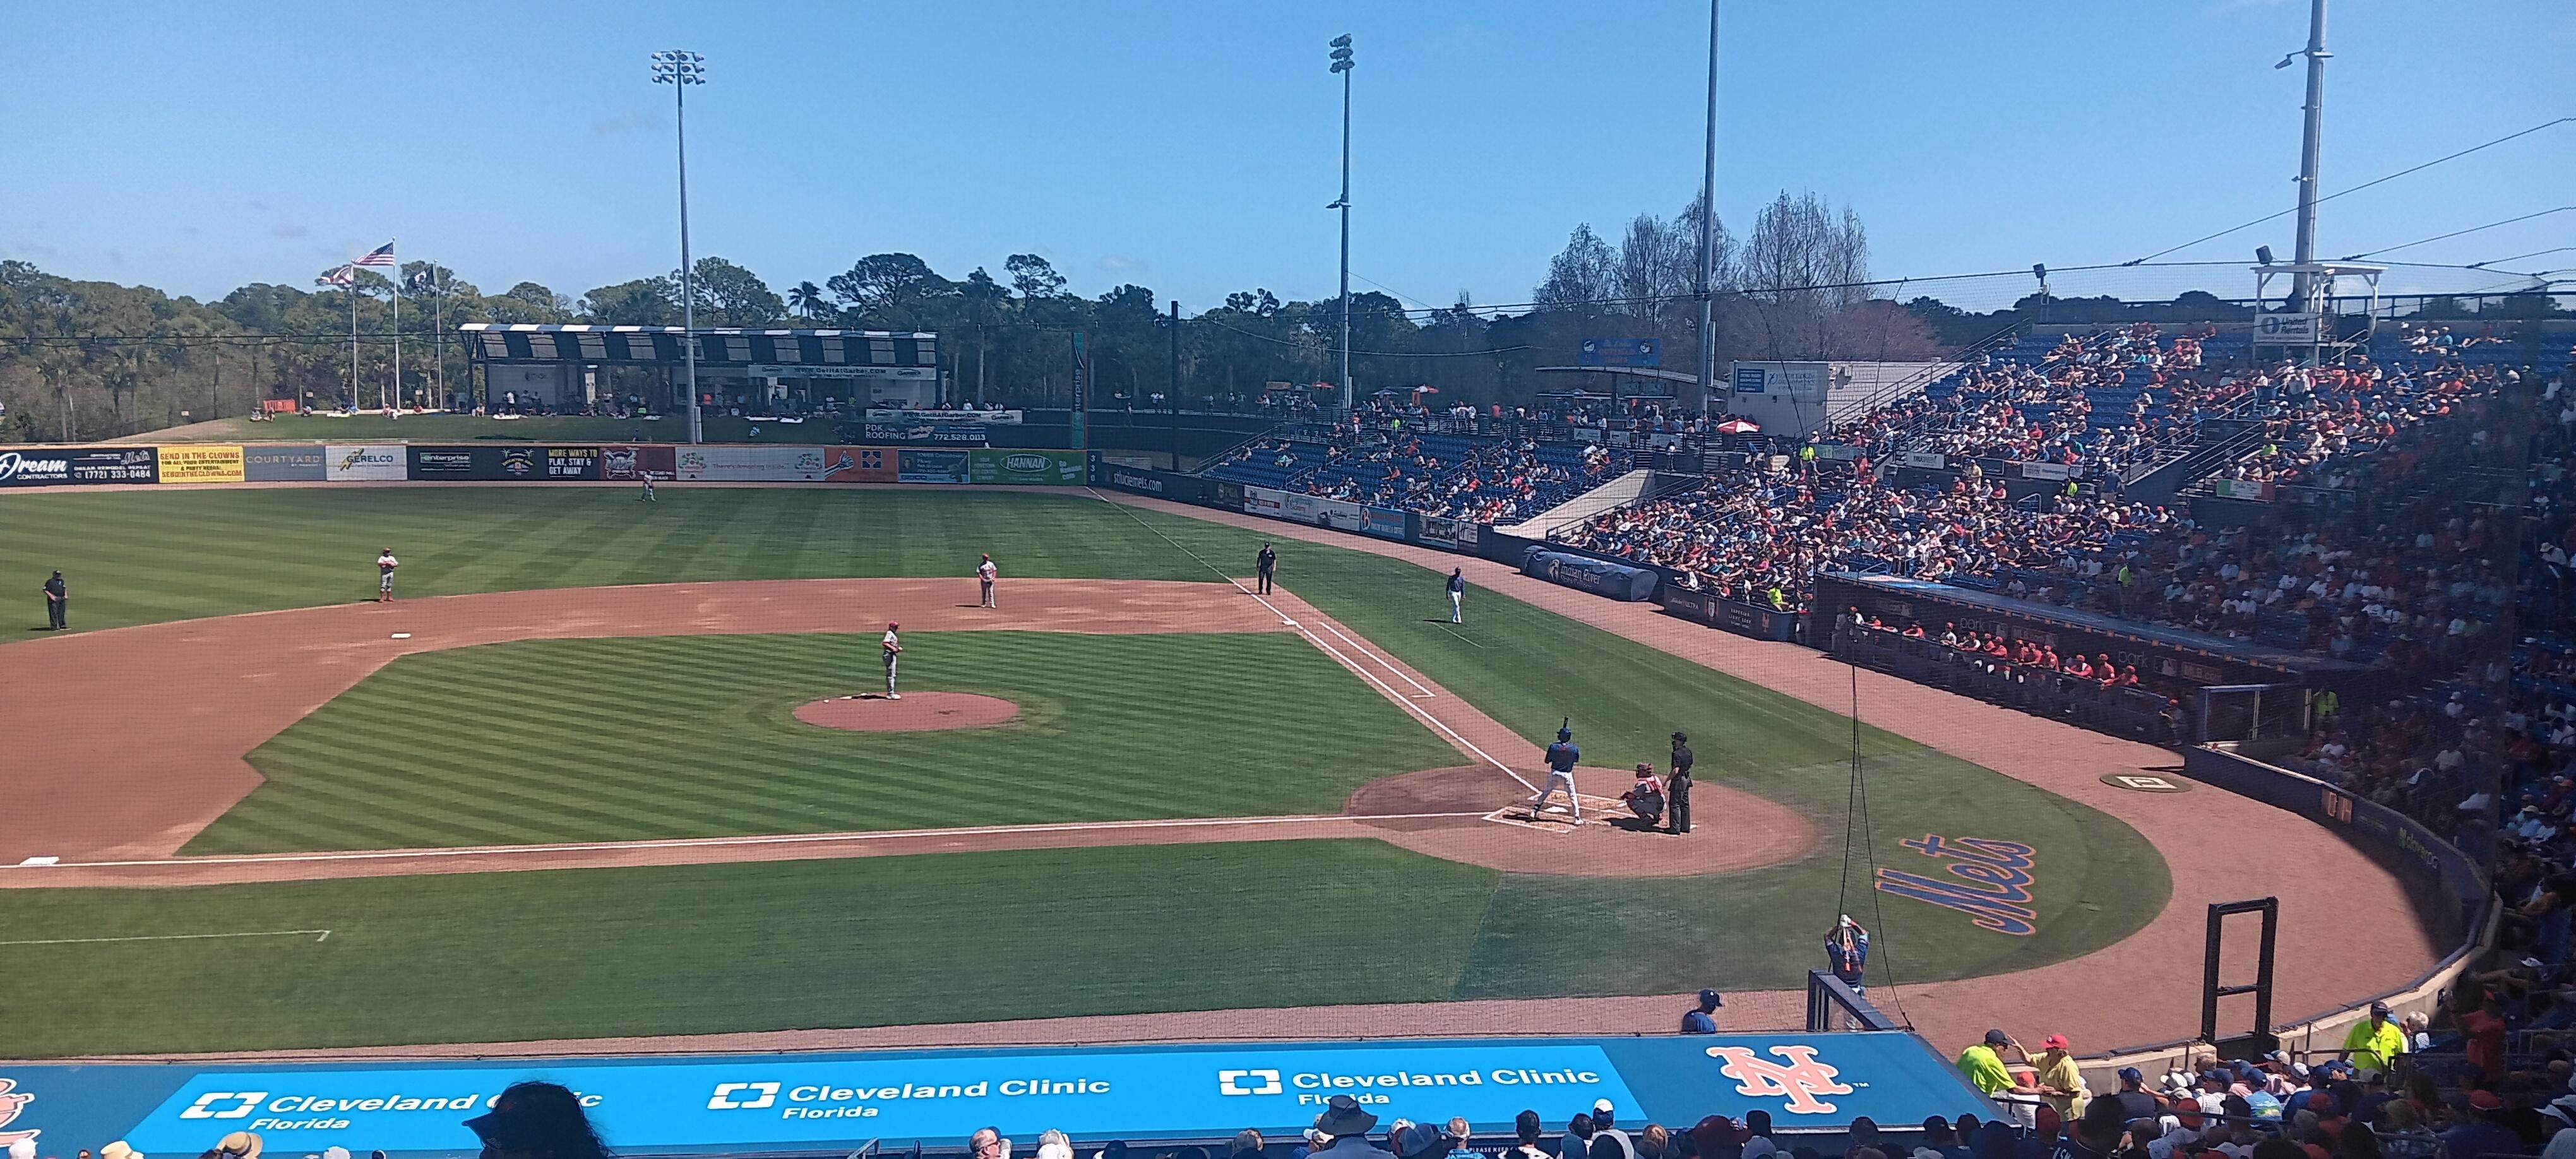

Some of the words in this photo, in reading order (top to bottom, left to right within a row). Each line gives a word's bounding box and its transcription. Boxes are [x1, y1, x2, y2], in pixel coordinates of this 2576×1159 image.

[2282, 317, 2308, 326] United
[2281, 326, 2309, 334] Rentals
[866, 431, 906, 440] ROOFING
[246, 455, 319, 463] COURTYARD
[548, 449, 567, 458] MORE
[568, 449, 588, 458] WAYS
[589, 449, 598, 458] TO
[0, 452, 67, 480] Dream
[548, 458, 567, 467] PLAY,
[568, 458, 585, 466] STAY
[1006, 456, 1046, 469] HANNAN
[110, 470, 151, 478] 333-0484
[162, 470, 242, 478] SENDINTHECLOWNS.COM
[549, 467, 562, 475] GET
[563, 467, 582, 475] AWAY
[1583, 569, 1601, 585] River
[1960, 617, 1986, 632] park
[2118, 651, 2147, 668] park
[2184, 664, 2222, 685] MLB.com
[1875, 833, 2037, 936] Mets
[1292, 1071, 1482, 1088] Cleveland
[1491, 1068, 1600, 1085] Clinic
[789, 1081, 987, 1102] Cleveland
[999, 1078, 1111, 1095] Clinic
[268, 1093, 480, 1113] Cleveland
[781, 1105, 878, 1119] Florida
[247, 1117, 350, 1130] Florida
